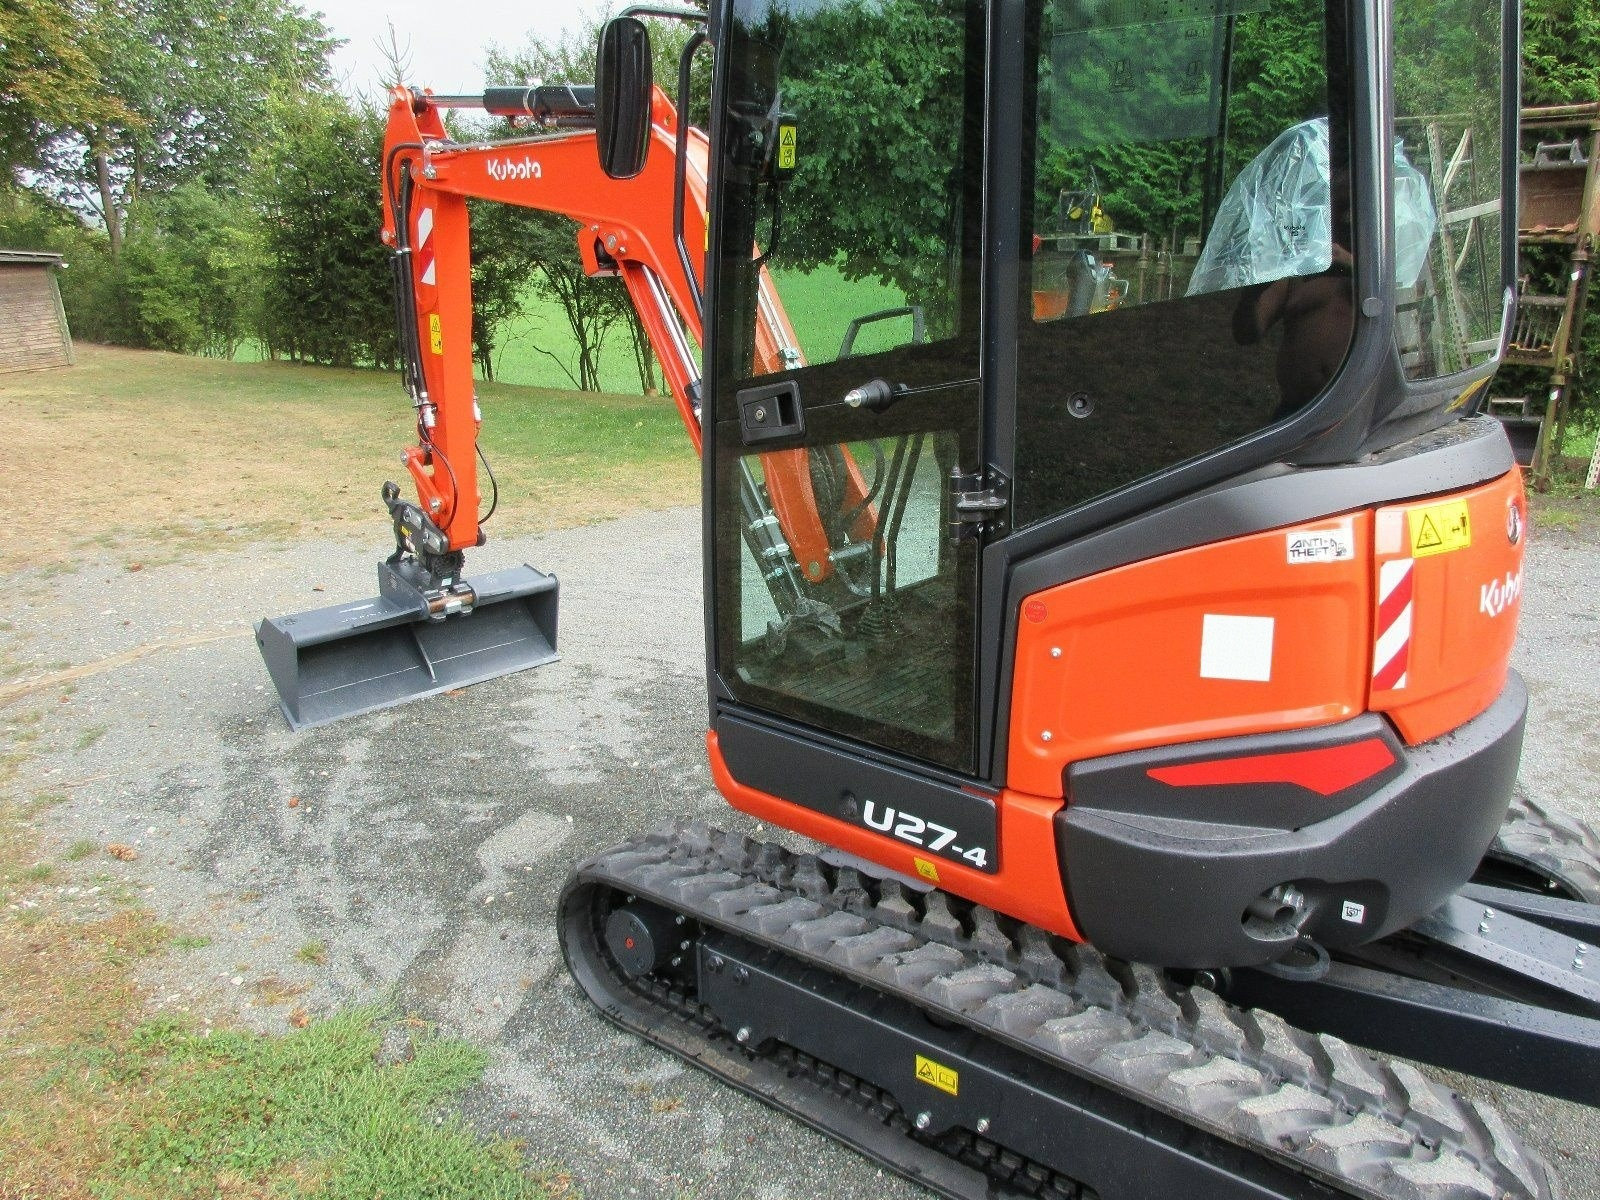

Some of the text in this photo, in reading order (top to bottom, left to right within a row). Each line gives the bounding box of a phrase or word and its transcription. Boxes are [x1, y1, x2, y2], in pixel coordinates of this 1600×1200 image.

[487, 156, 542, 181] Kubota
[1289, 546, 1330, 558] THEFT
[1479, 571, 1521, 618] Kubo
[863, 800, 987, 868] U27-4
